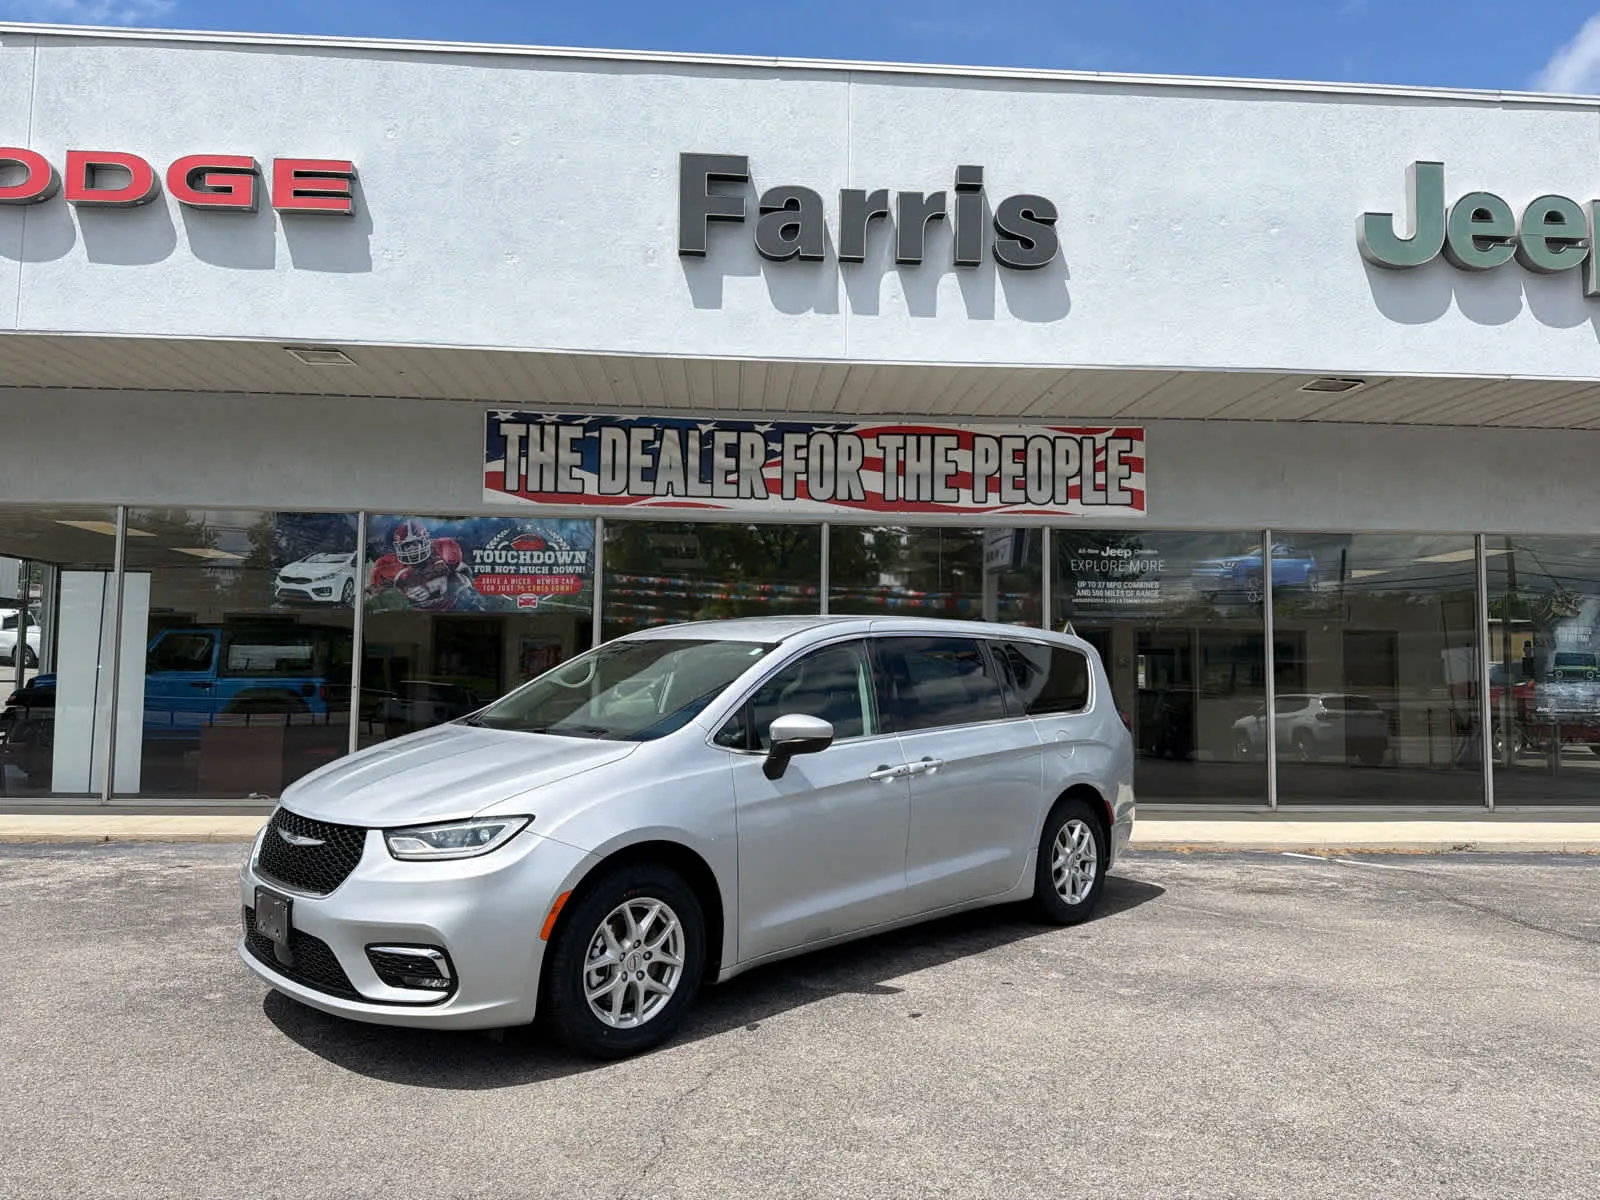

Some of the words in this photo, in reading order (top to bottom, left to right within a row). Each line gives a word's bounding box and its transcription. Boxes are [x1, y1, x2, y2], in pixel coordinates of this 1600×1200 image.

[678, 152, 1060, 270] Farris
[1355, 161, 1600, 297] Jee
[499, 422, 585, 494] THE
[598, 425, 769, 500] DEALER
[781, 430, 867, 502] FOR
[876, 433, 960, 503] THE
[972, 434, 1134, 506] PEOPLE
[472, 550, 587, 564] TOUCHDOWN
[1100, 546, 1132, 558] Jeep
[474, 565, 491, 573] FOR
[495, 566, 516, 574] NOT
[520, 566, 549, 574] MUCH
[552, 566, 586, 574] DOWN!
[1071, 560, 1128, 572] EXPLORE
[1129, 560, 1165, 572] MORE
